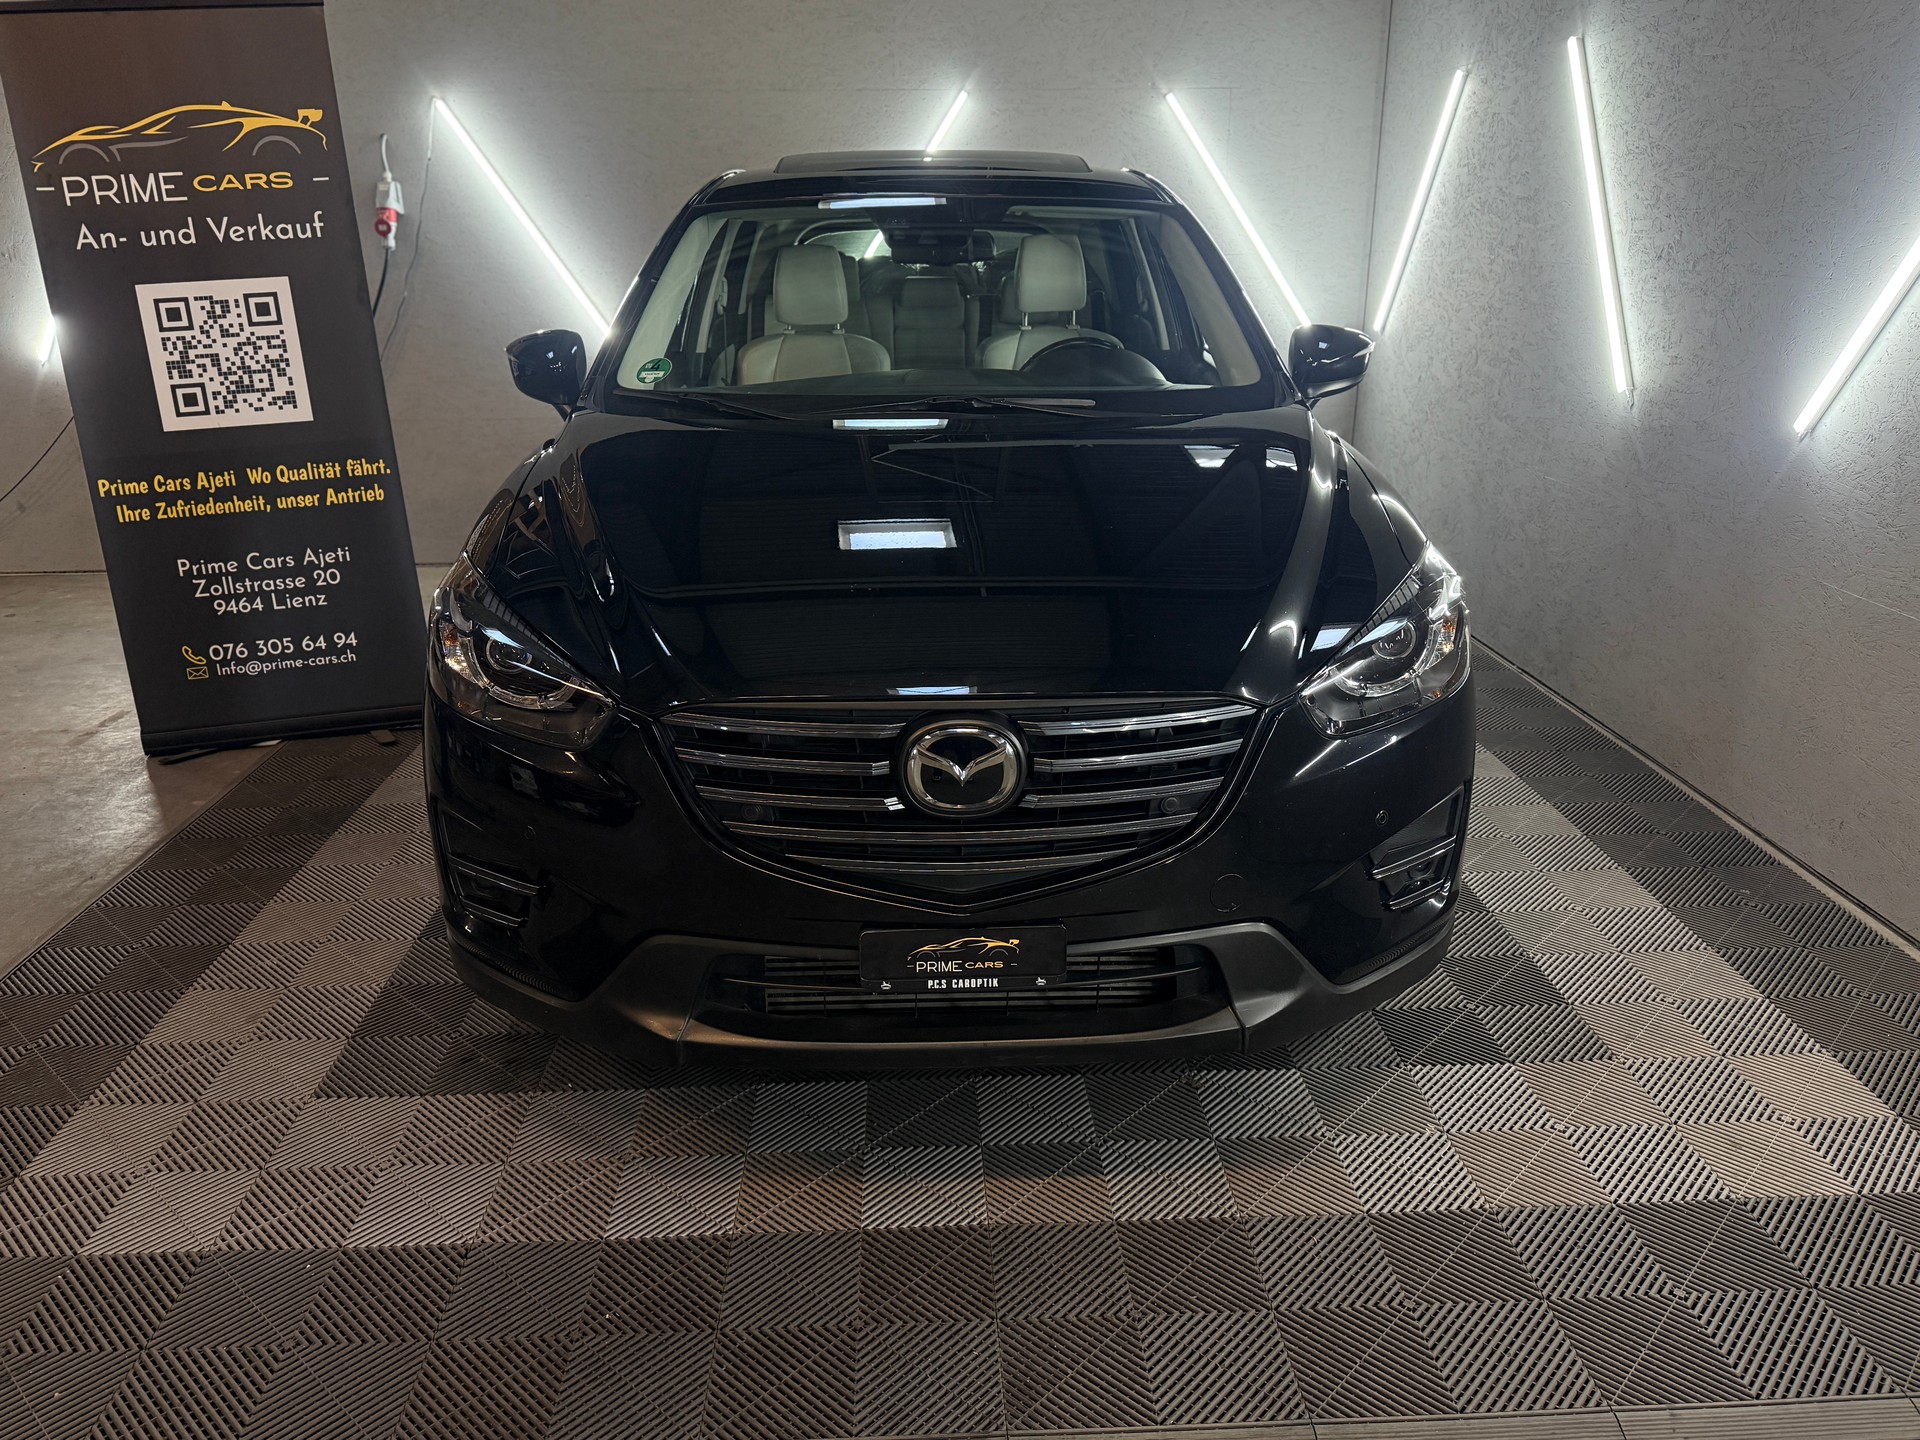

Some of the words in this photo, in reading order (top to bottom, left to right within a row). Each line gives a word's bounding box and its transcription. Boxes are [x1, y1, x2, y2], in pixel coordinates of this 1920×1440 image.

[61, 171, 188, 206] PRIME
[192, 171, 294, 192] CARS
[76, 223, 127, 250] An-
[140, 217, 197, 246] und
[206, 210, 325, 243] Verkauf
[97, 479, 149, 498] Prime
[153, 474, 191, 493] Cars
[197, 470, 236, 495] Ajeti
[246, 467, 272, 485] Wo
[276, 461, 341, 484] Qualität
[346, 458, 391, 478] fährt.
[116, 505, 151, 523] Ihre
[155, 494, 271, 520] Zufriedenheit,
[277, 491, 320, 509] unser
[326, 484, 385, 506] Antrieb
[176, 558, 238, 577] Prime
[246, 552, 295, 571] Cars
[303, 546, 351, 568] Ajeti
[192, 576, 306, 598] Zollstrasse
[313, 568, 341, 587] 20
[213, 597, 264, 616] 9464
[271, 593, 328, 610] Lienz
[208, 642, 248, 661] 076
[256, 637, 294, 656] 305
[302, 634, 327, 651] 64
[333, 631, 358, 648] 94
[216, 649, 357, 677] Info@prime-cars.ch
[916, 960, 963, 973] PRIME
[964, 961, 1004, 969] CARS
[927, 979, 947, 989] P.C.S
[952, 977, 999, 988] CAROPTIK
